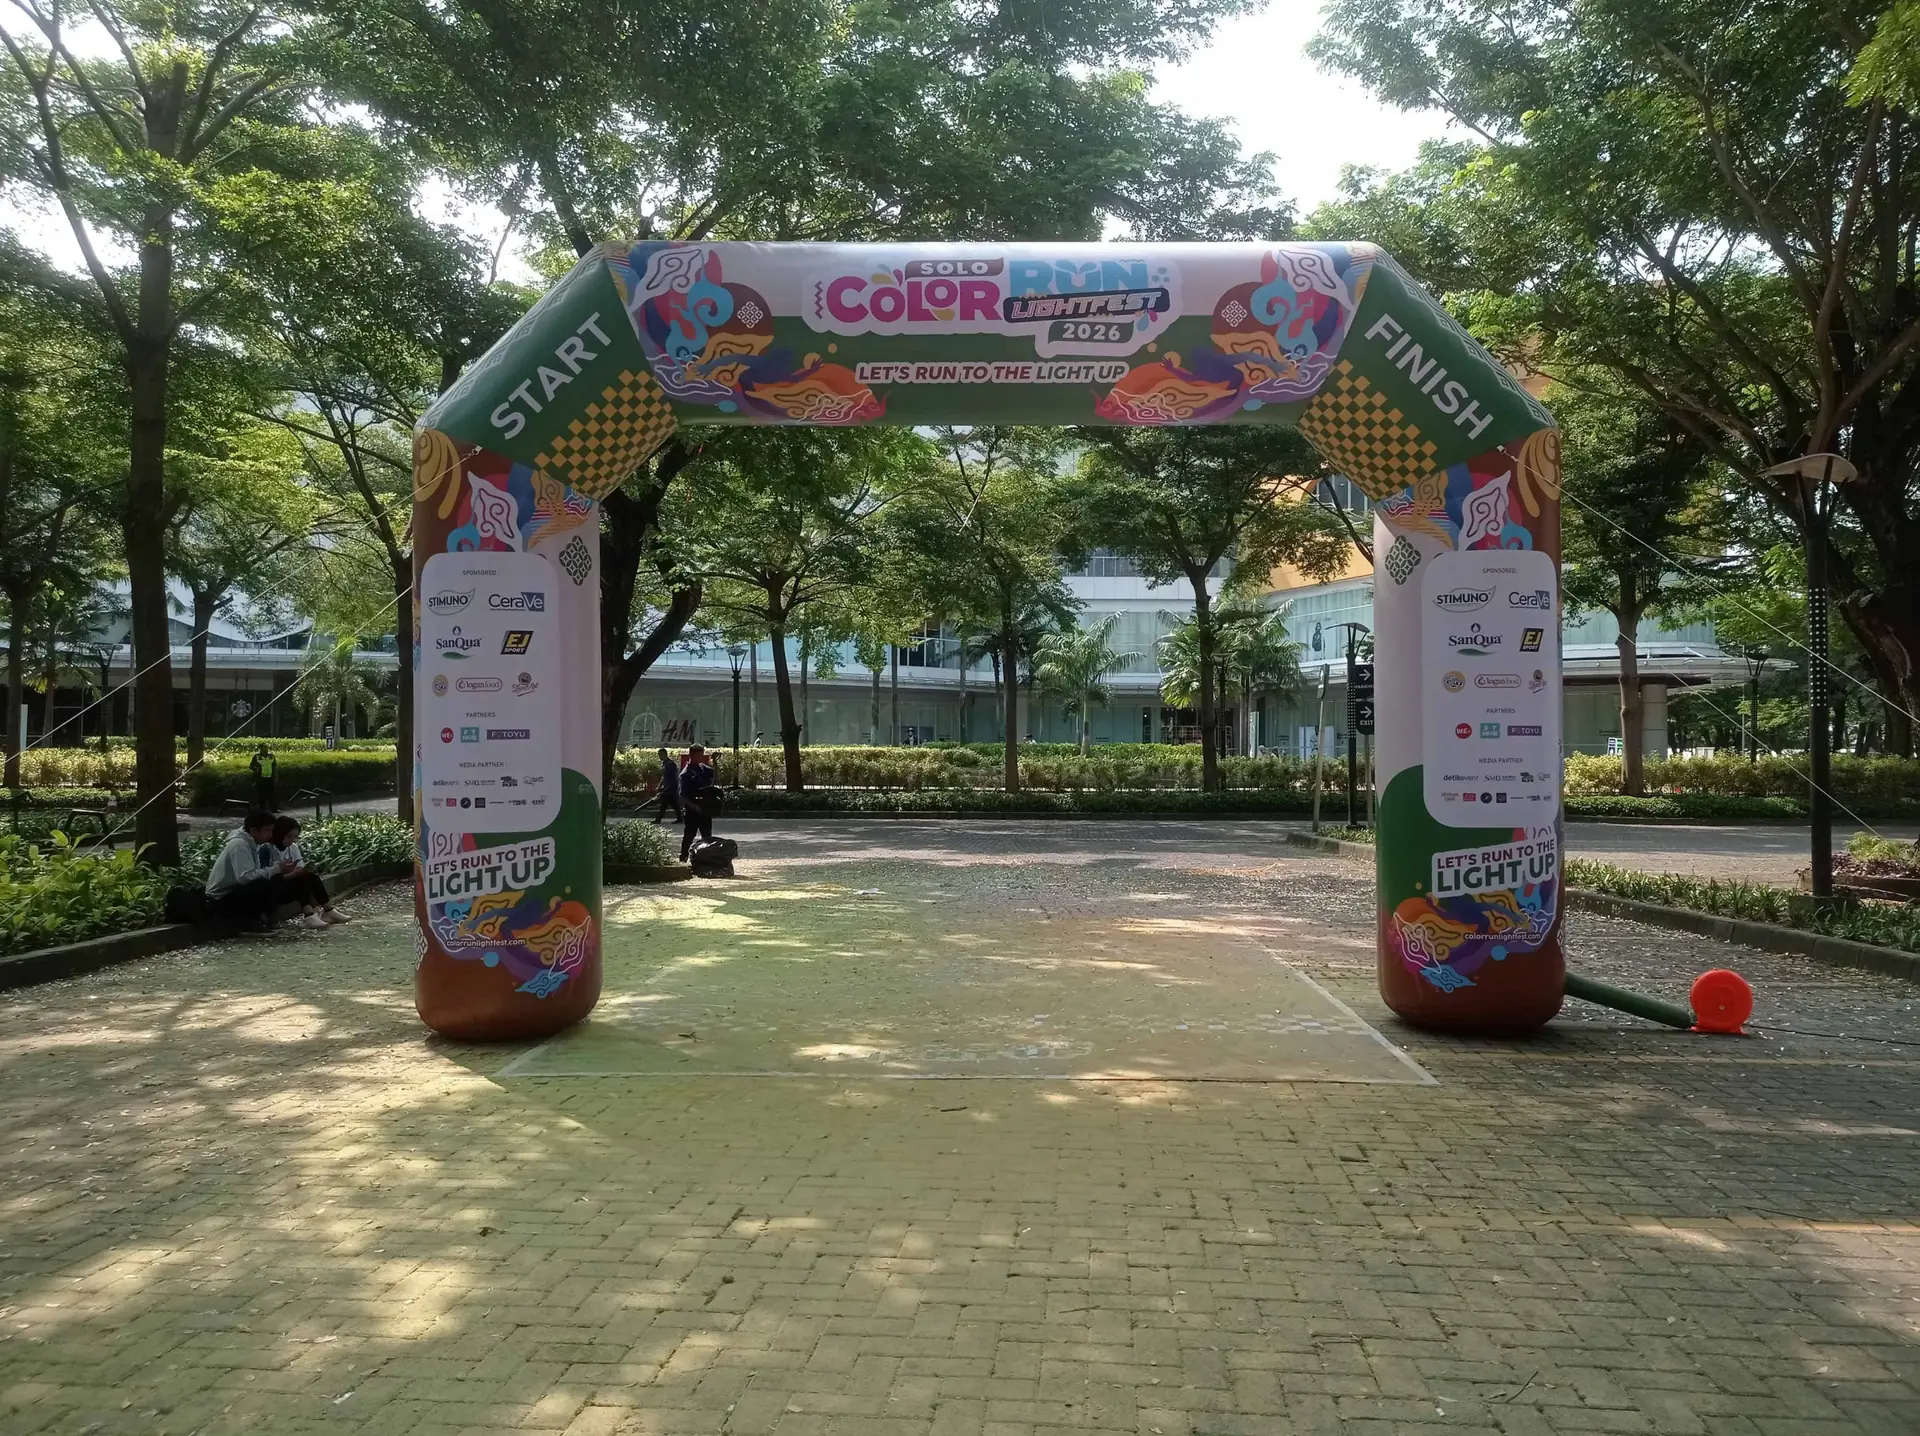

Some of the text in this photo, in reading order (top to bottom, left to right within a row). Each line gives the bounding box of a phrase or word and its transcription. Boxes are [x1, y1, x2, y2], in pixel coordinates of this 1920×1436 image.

[920, 262, 989, 275] SOLO
[826, 260, 1149, 324] COLOR RUN
[1011, 291, 1162, 319] LIGHTFEST
[1062, 322, 1121, 342] 2026
[490, 311, 612, 440] START
[858, 364, 1126, 381] LET'S RUN TO THE LIGHT UP
[1364, 313, 1494, 440] FINISH
[428, 595, 469, 607] STIMUNO
[488, 592, 544, 608] CeraVe
[1436, 592, 1489, 605] STIMUNO
[1508, 591, 1550, 606] CeraVe
[435, 637, 481, 651] SanQua
[505, 633, 531, 648] EJ
[1448, 634, 1502, 648] SanQua
[1523, 631, 1542, 645] EJ
[661, 719, 697, 742] H&M
[428, 842, 550, 876] LET'S RUN TO THE
[1437, 839, 1555, 870] LET'S RUN TO THE
[428, 856, 551, 900] LIGHT UP
[1437, 852, 1556, 892] LIGHT UP
[446, 938, 526, 949] colorrunlightfest.com
[1464, 932, 1541, 942] colorrunlightfest.com
